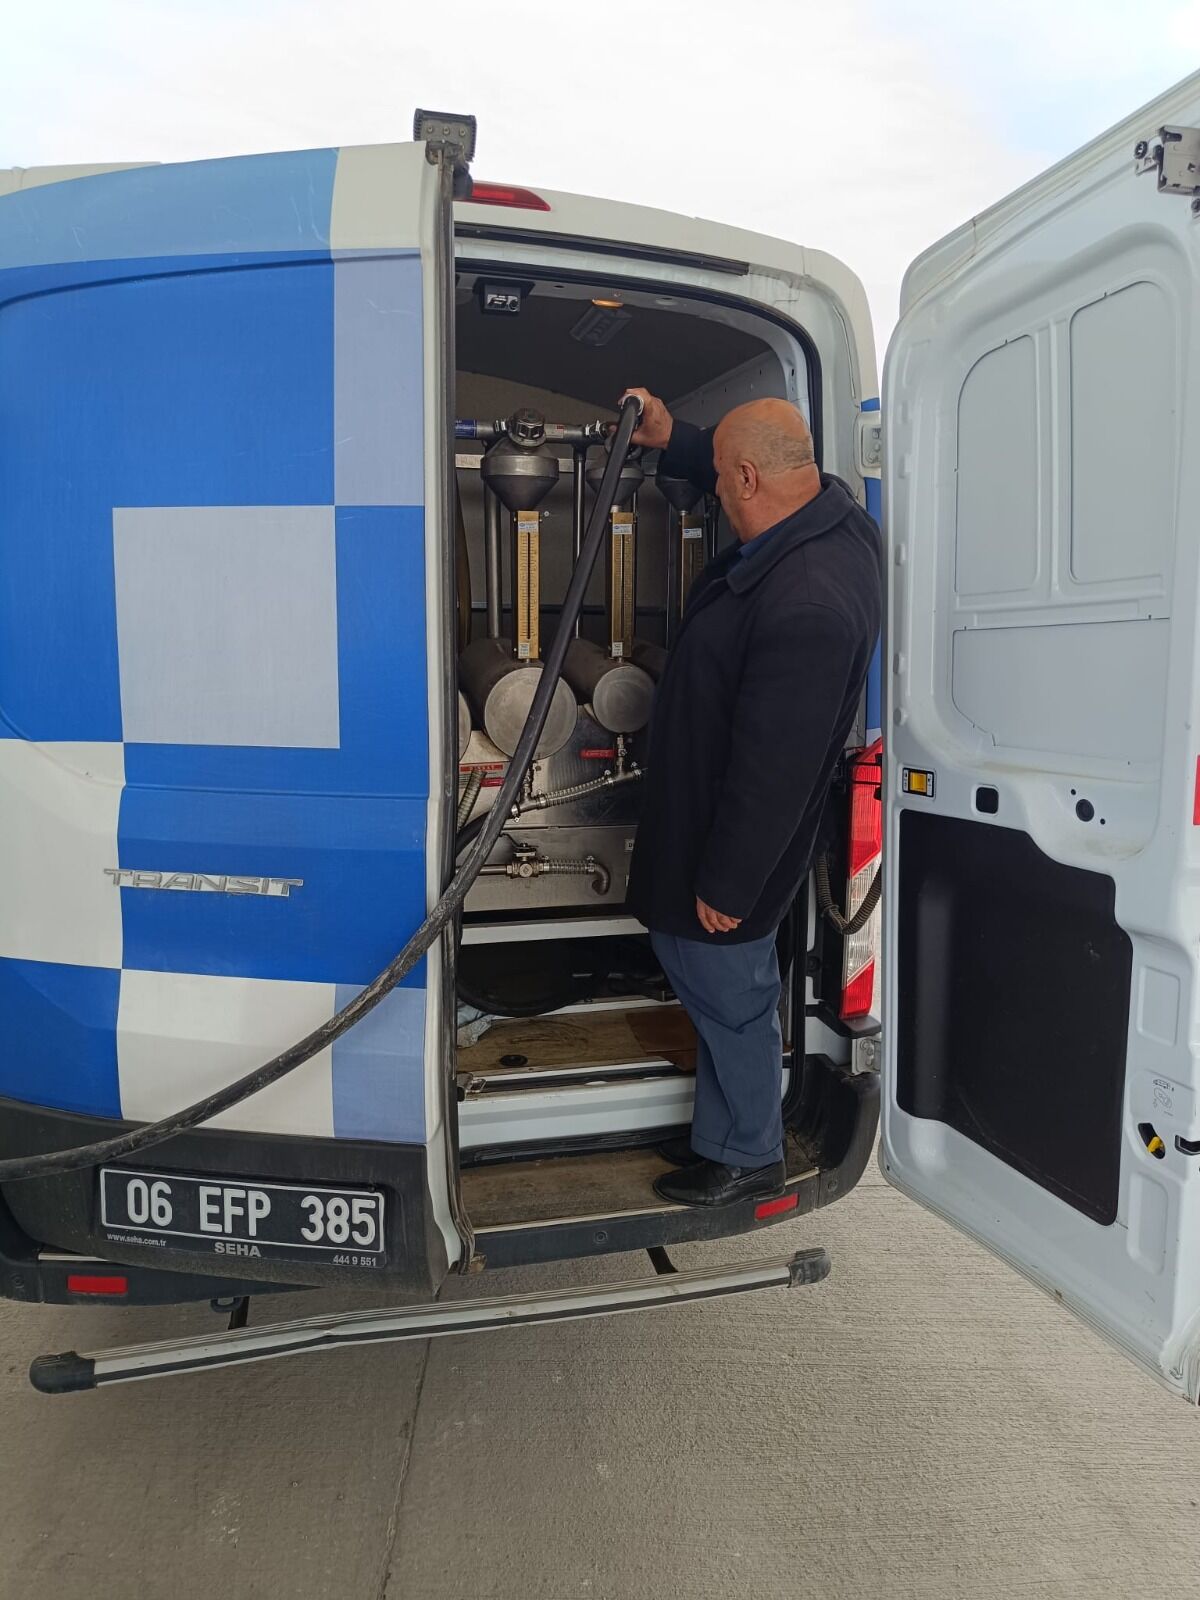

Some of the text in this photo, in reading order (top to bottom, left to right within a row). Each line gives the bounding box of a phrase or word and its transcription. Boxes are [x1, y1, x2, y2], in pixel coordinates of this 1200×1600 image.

[103, 868, 304, 897] TRANSIT
[126, 1179, 376, 1246] 06 EFP 385
[214, 1241, 262, 1258] SEHA
[332, 1254, 377, 1267] 444 9 551
